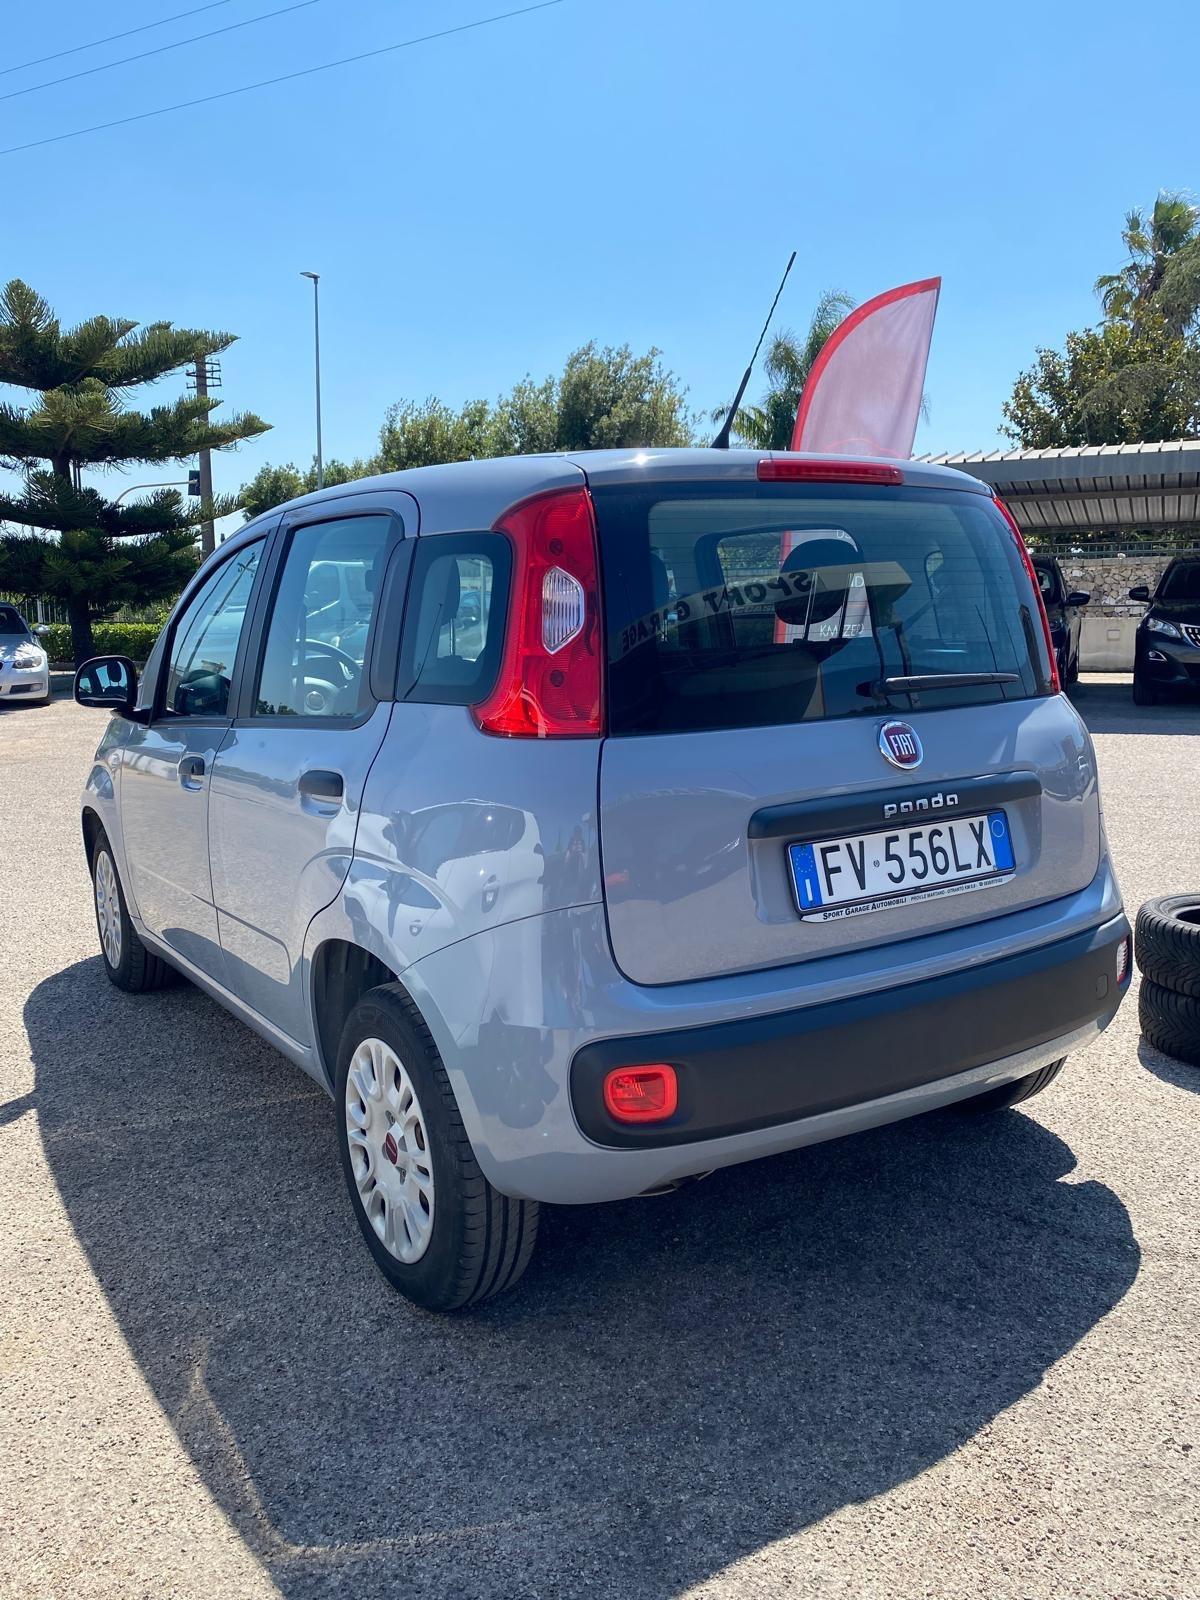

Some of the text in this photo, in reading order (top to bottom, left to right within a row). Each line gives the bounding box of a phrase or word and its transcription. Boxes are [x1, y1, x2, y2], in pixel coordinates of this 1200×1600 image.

[820, 624, 838, 637] KM
[889, 733, 916, 756] FIAT
[884, 793, 959, 818] panda
